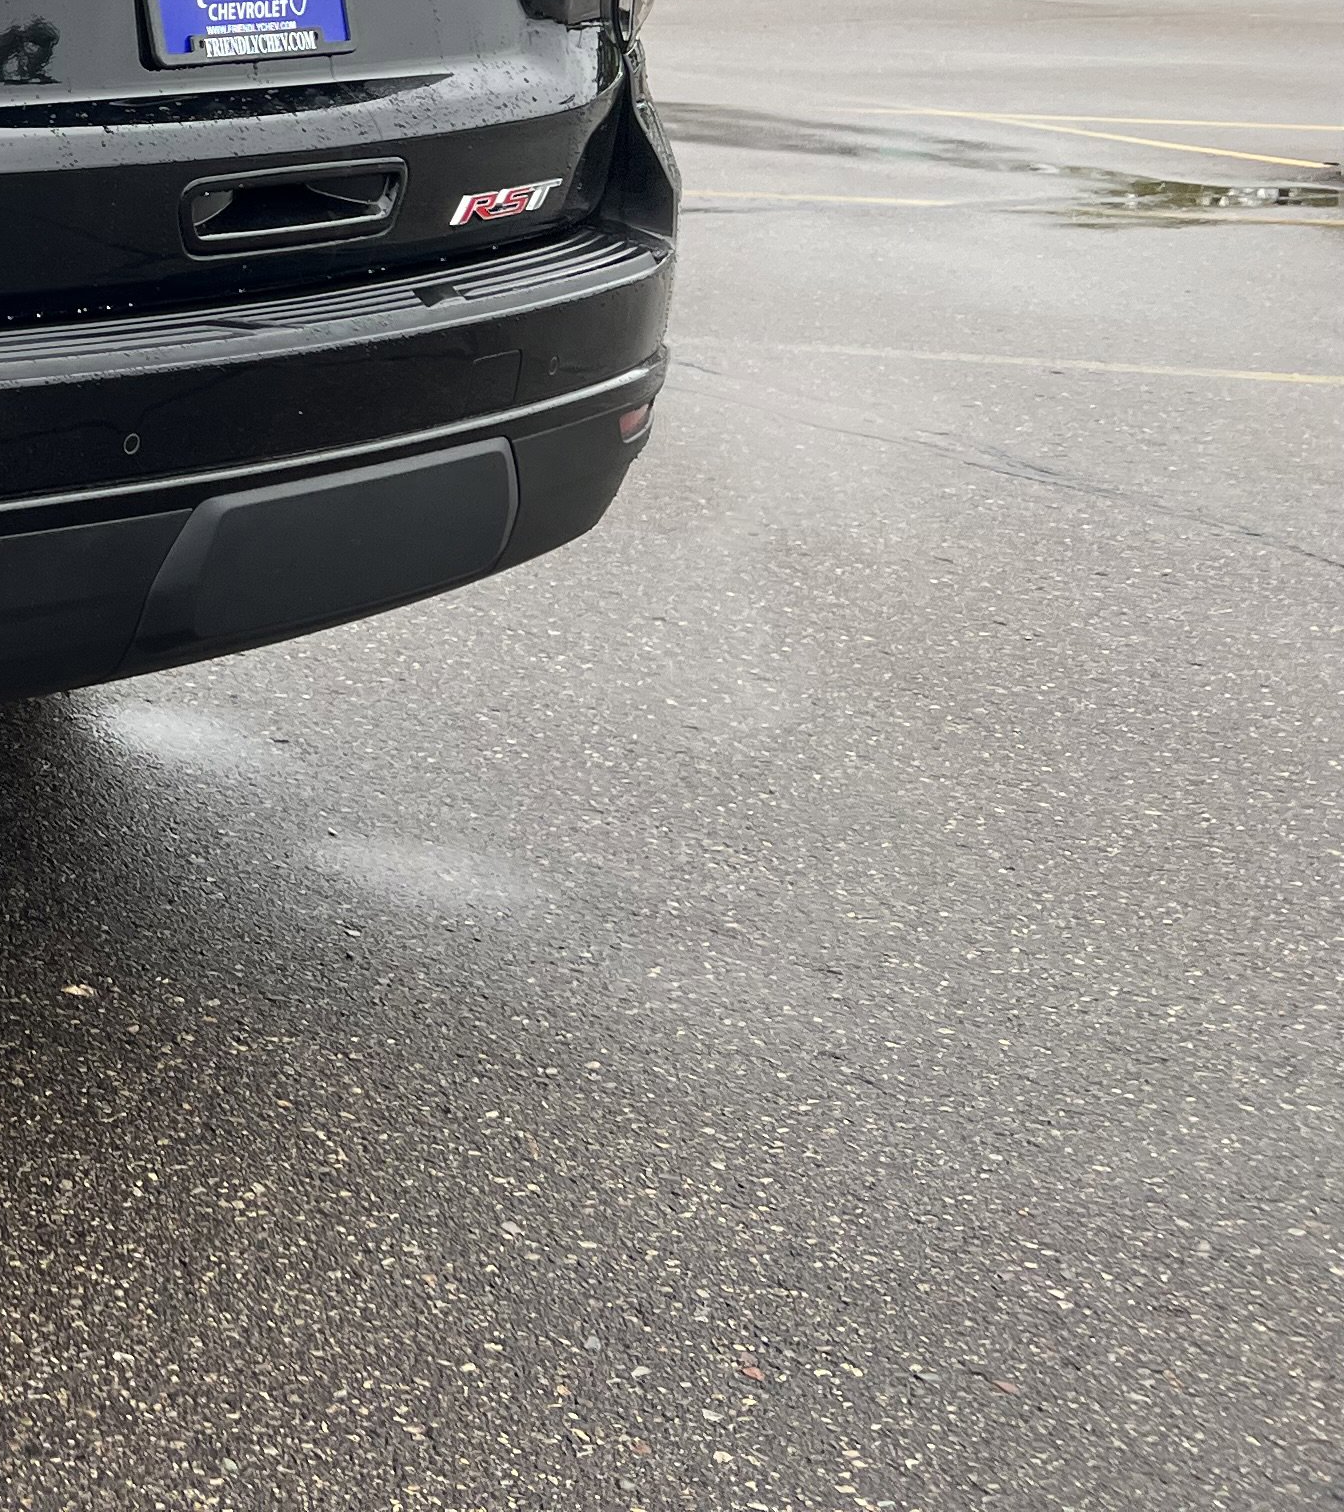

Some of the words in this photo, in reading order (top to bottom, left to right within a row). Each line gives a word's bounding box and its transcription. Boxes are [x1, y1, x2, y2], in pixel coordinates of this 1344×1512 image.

[206, 20, 297, 35] WWW.FRIENDLYCHEV.COM
[204, 30, 317, 58] FRIENDLYCHEV.COM
[449, 177, 563, 226] RST
